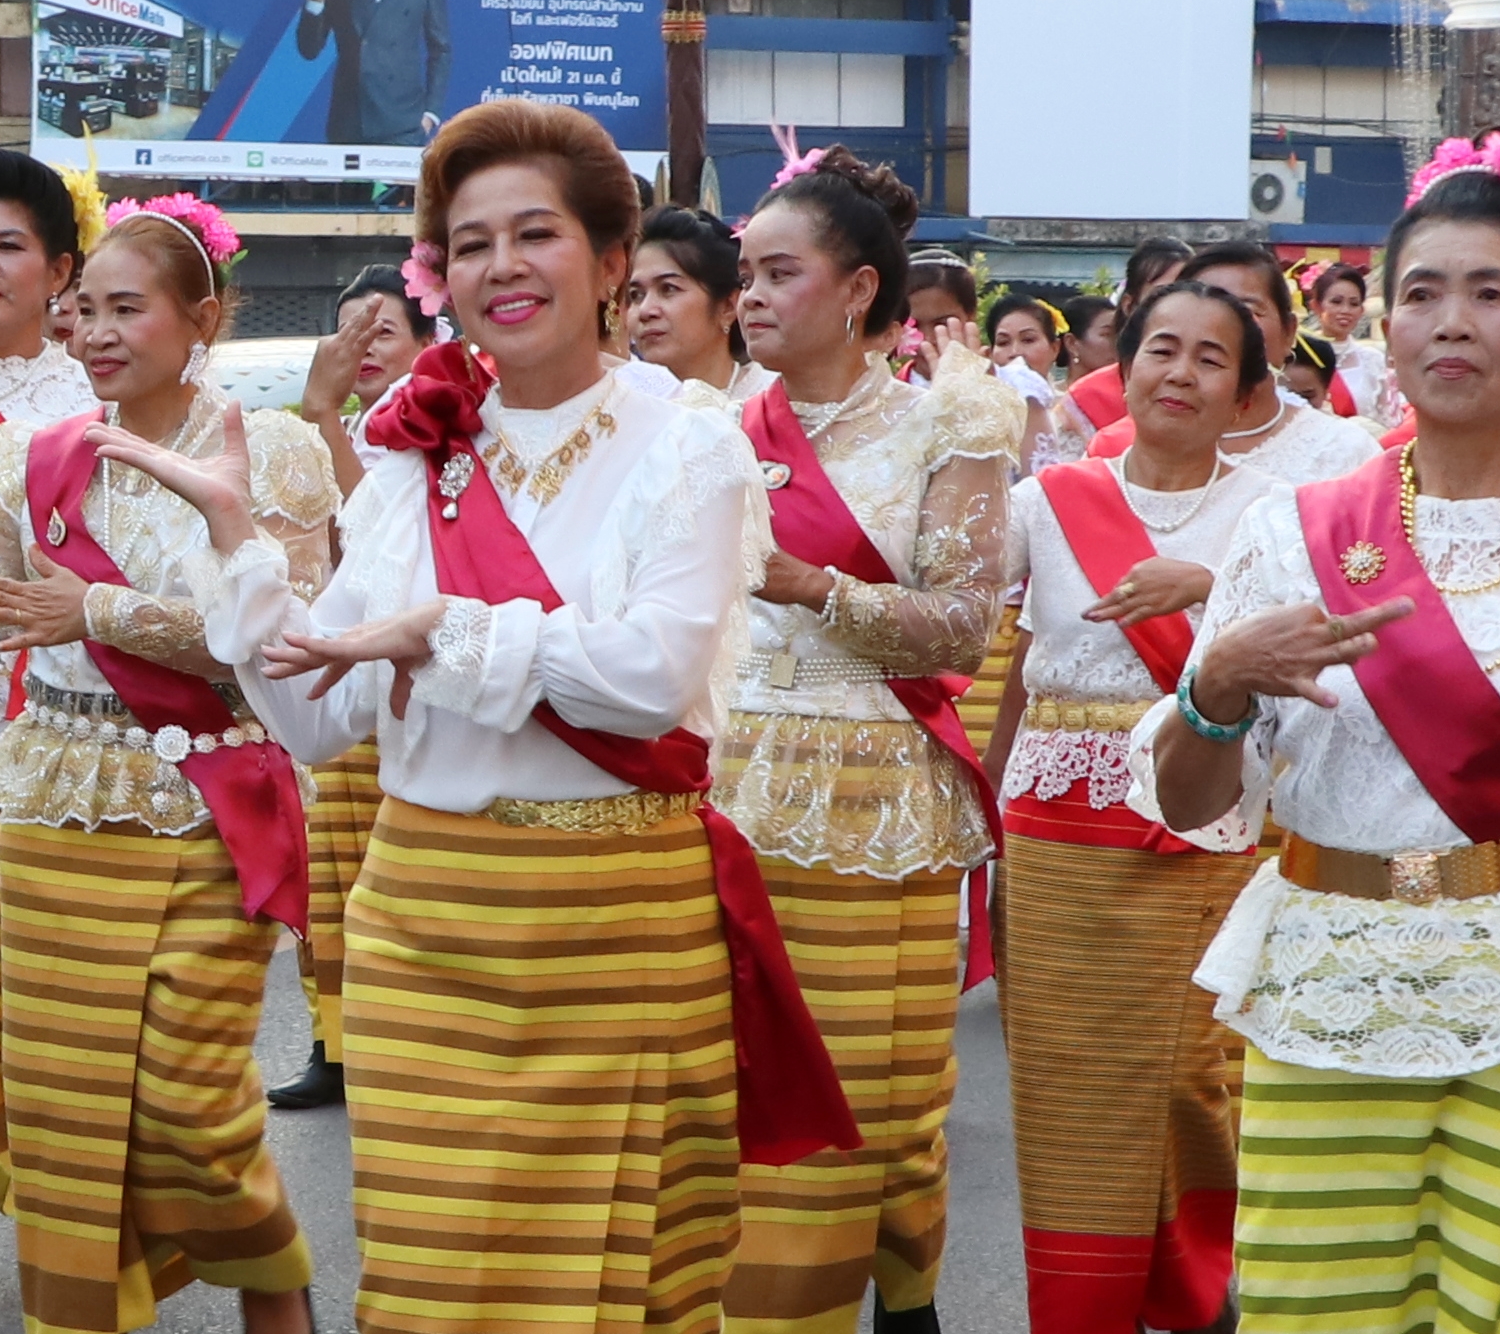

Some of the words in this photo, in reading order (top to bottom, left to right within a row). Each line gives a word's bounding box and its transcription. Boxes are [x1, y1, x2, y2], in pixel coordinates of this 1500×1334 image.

[510, 41, 613, 62] ออฟฟิศเมท
[501, 65, 562, 84] เปิดใหม่!
[567, 71, 580, 84] 21
[611, 68, 621, 85] นี้
[583, 91, 639, 109] พิษณุโลก
